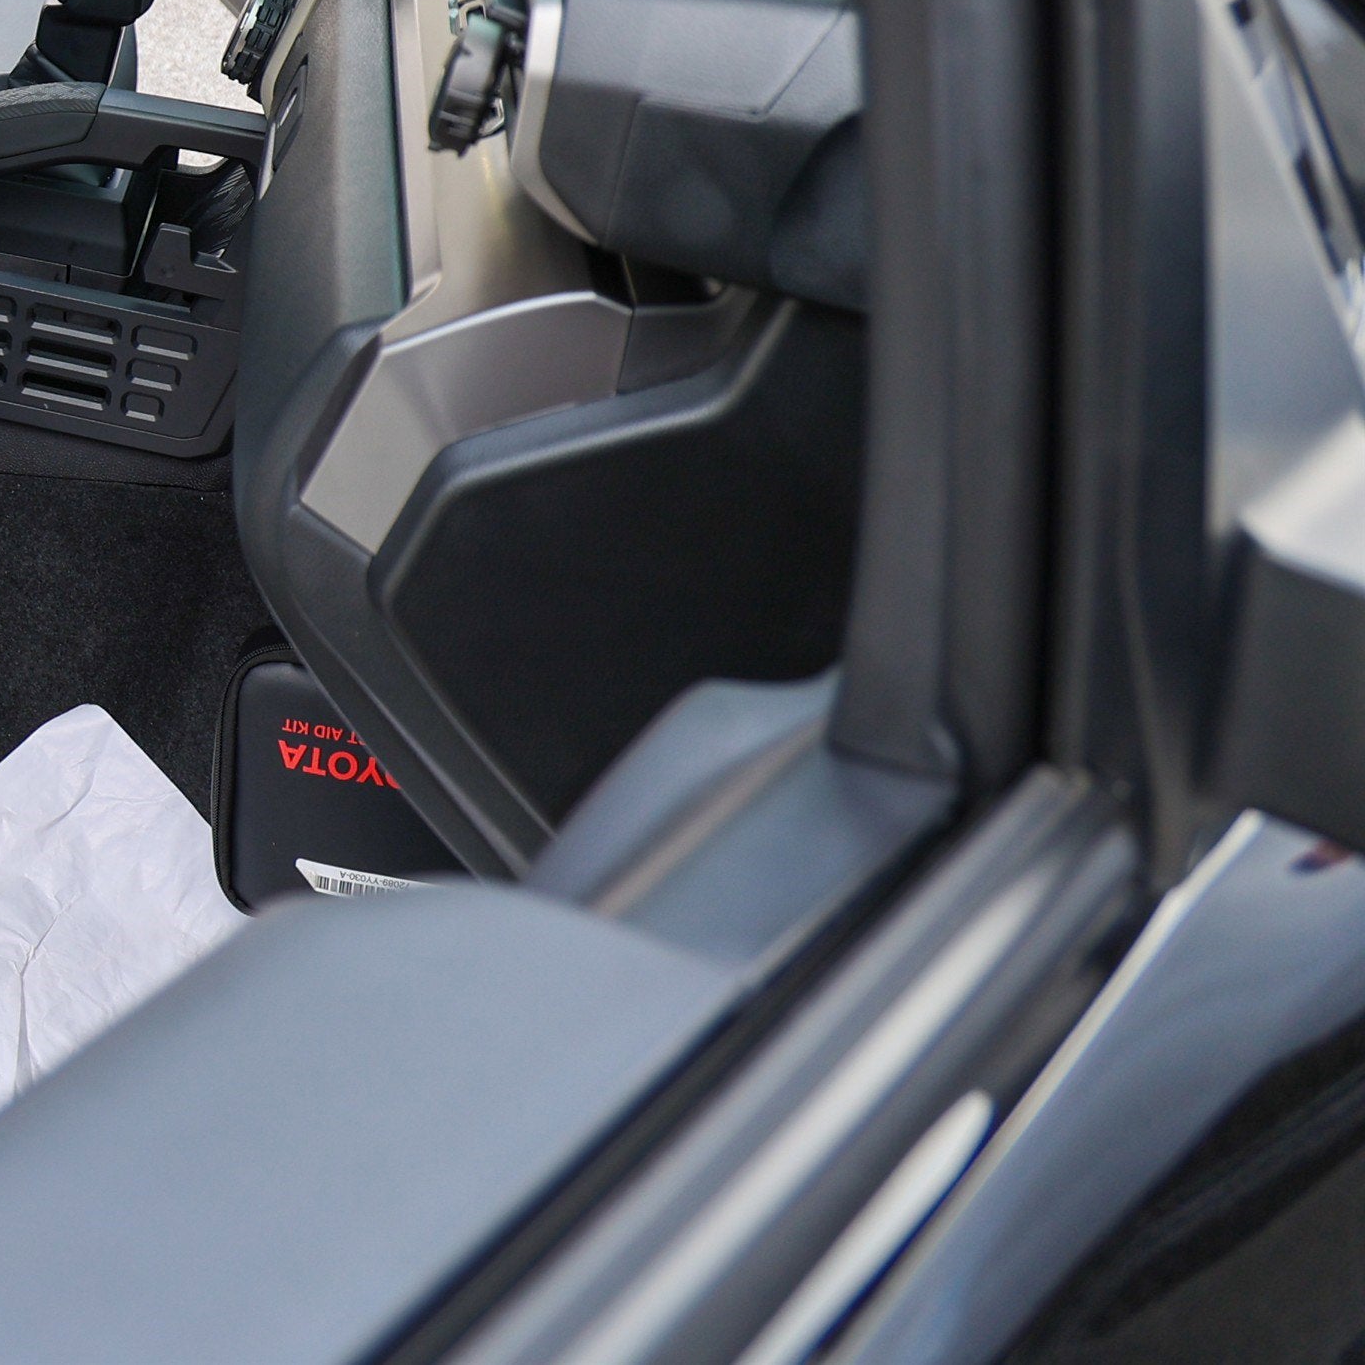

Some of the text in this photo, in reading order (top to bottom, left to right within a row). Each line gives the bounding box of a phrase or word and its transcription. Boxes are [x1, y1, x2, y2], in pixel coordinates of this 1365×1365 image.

[281, 718, 367, 746] T AID KIT
